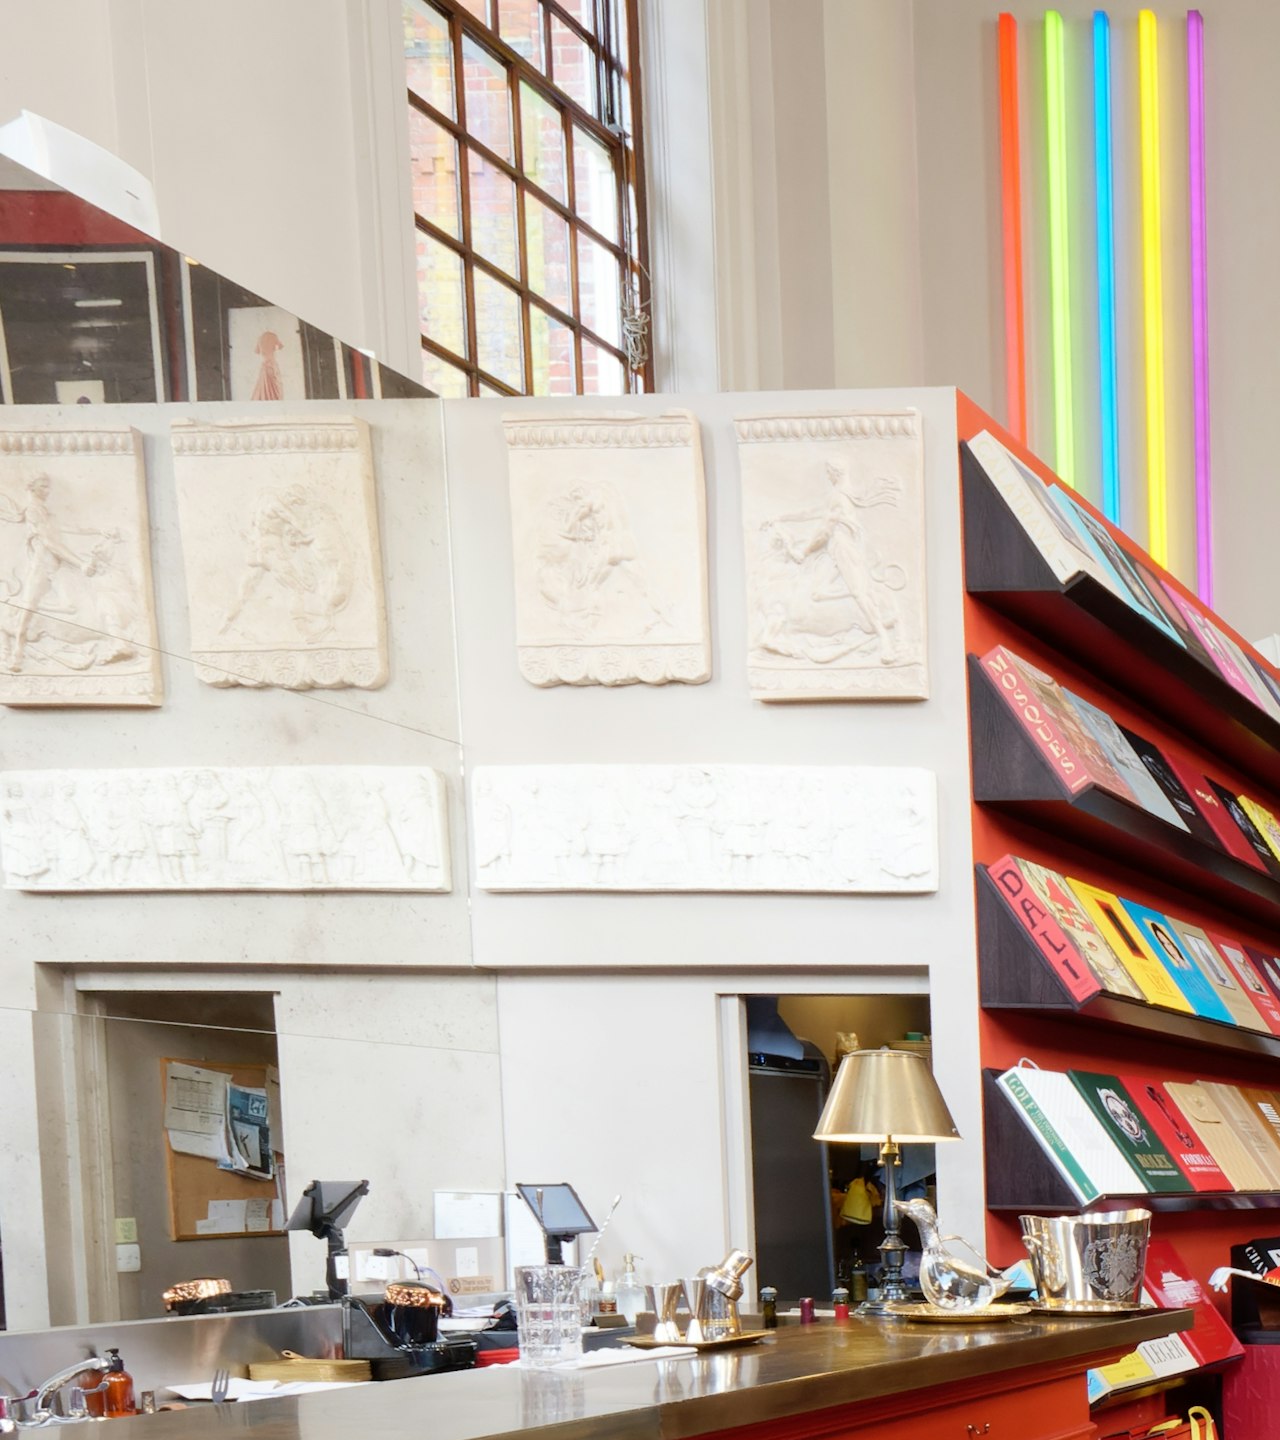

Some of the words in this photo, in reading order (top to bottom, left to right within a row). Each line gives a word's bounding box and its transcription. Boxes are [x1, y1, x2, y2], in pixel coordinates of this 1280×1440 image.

[988, 654, 1075, 775] MOSQUES
[997, 868, 1080, 980] DALI
[1007, 1077, 1038, 1111] GOLF
